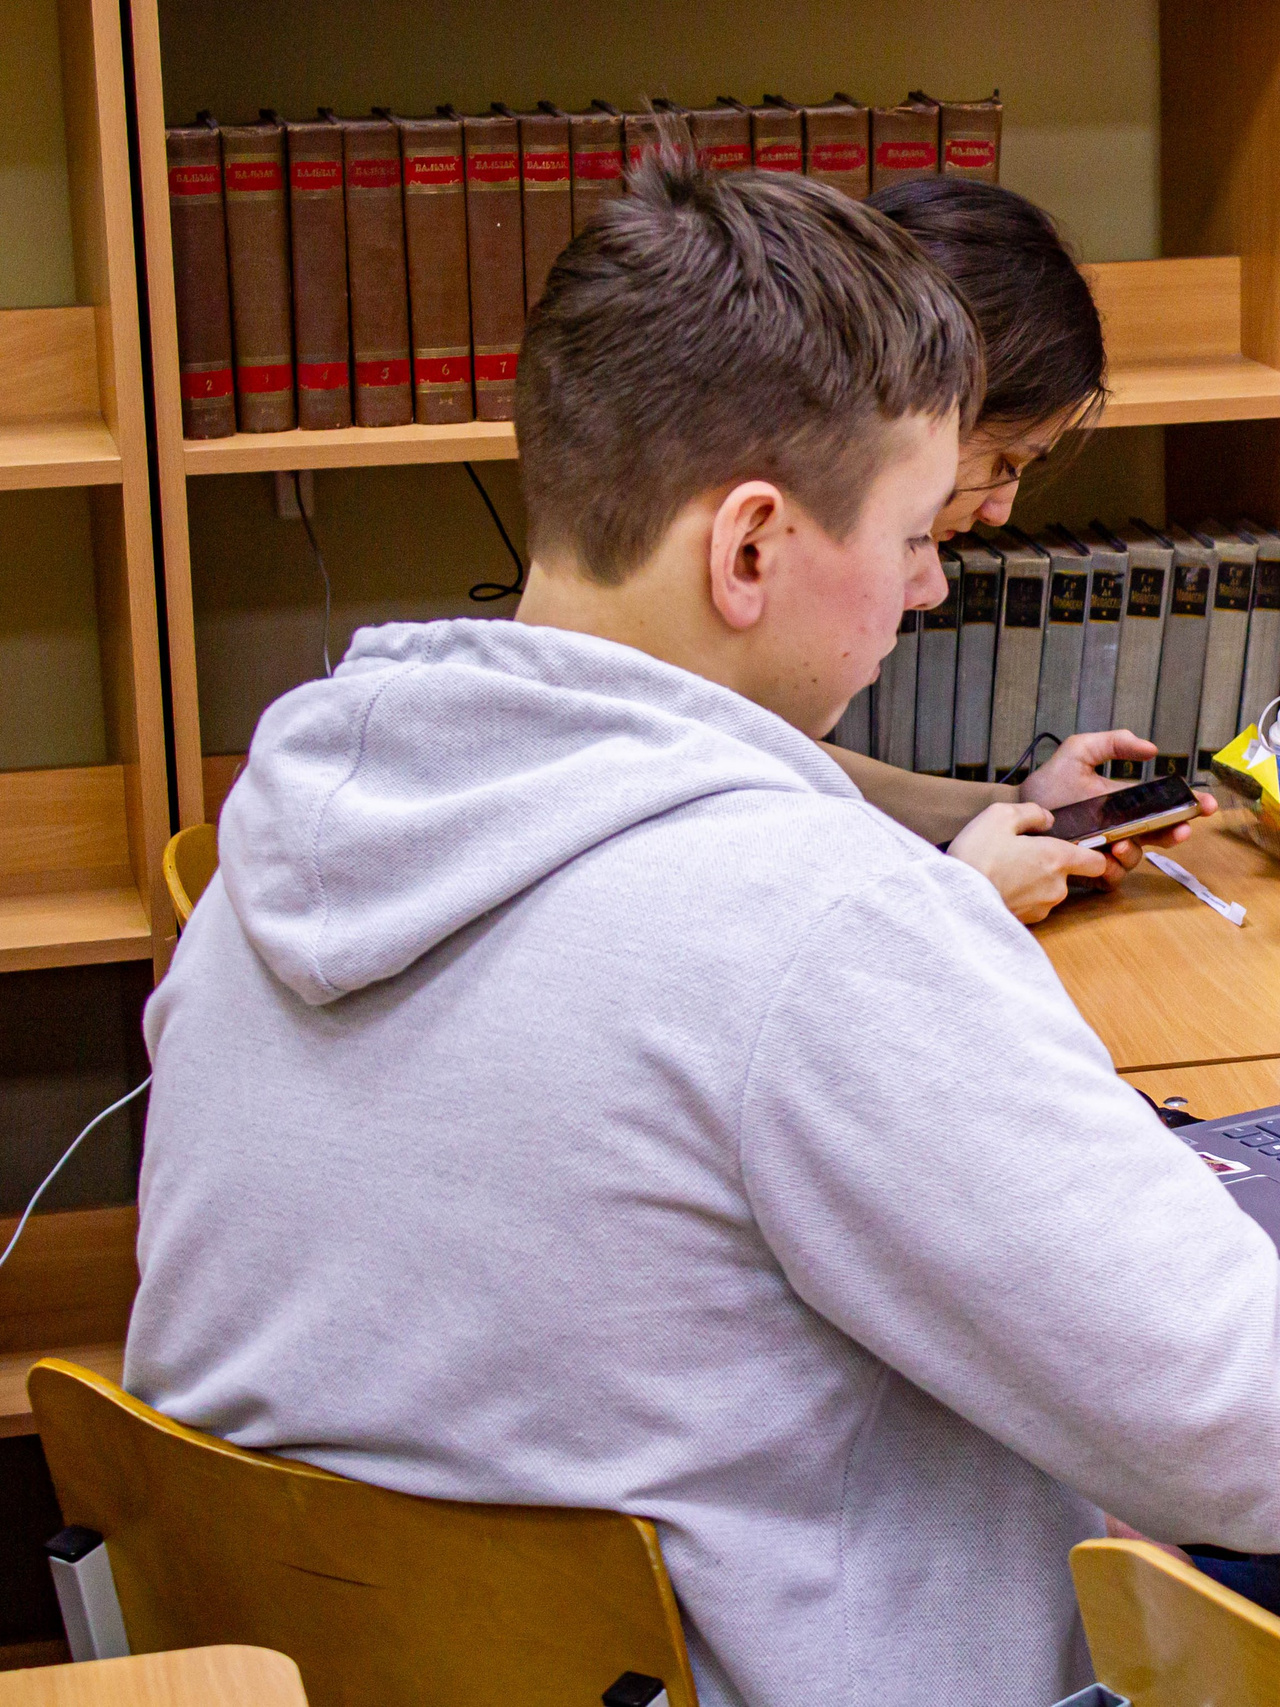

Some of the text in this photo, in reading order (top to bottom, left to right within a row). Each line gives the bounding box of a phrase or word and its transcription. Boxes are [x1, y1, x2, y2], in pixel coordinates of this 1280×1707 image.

[415, 163, 456, 173] БАЛЬЗАК
[442, 363, 449, 375] 6
[500, 361, 507, 373] 7
[206, 379, 213, 391] 2
